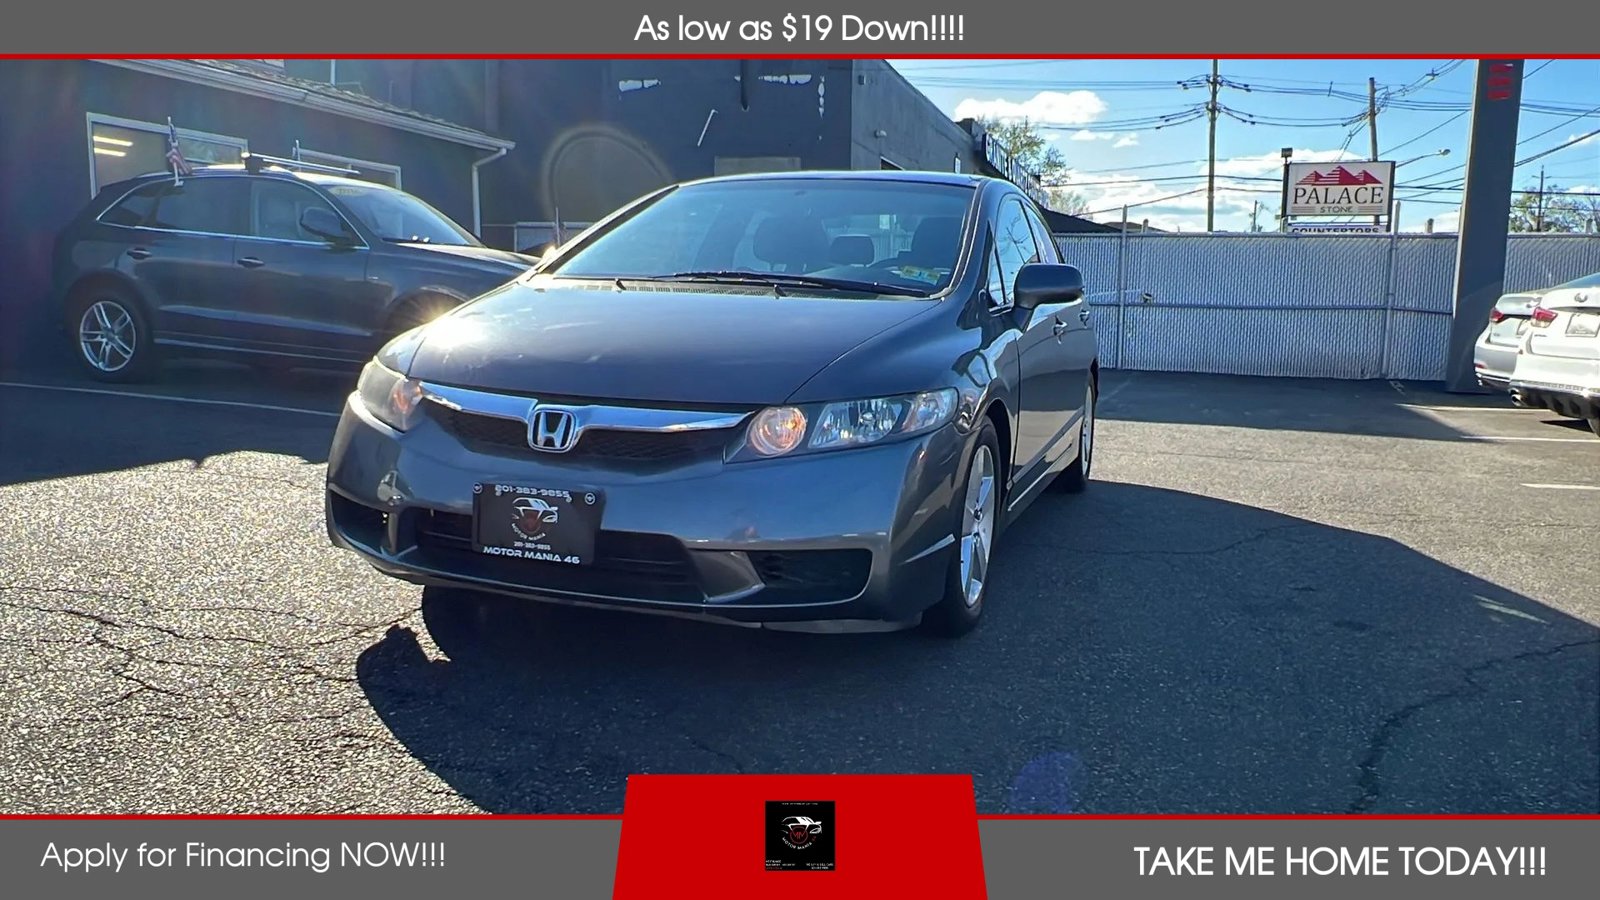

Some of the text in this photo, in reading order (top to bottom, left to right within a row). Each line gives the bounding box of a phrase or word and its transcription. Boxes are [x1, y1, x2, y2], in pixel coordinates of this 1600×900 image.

[1293, 187, 1384, 204] PALACE
[483, 546, 580, 564] MOTOR MANIA 46
